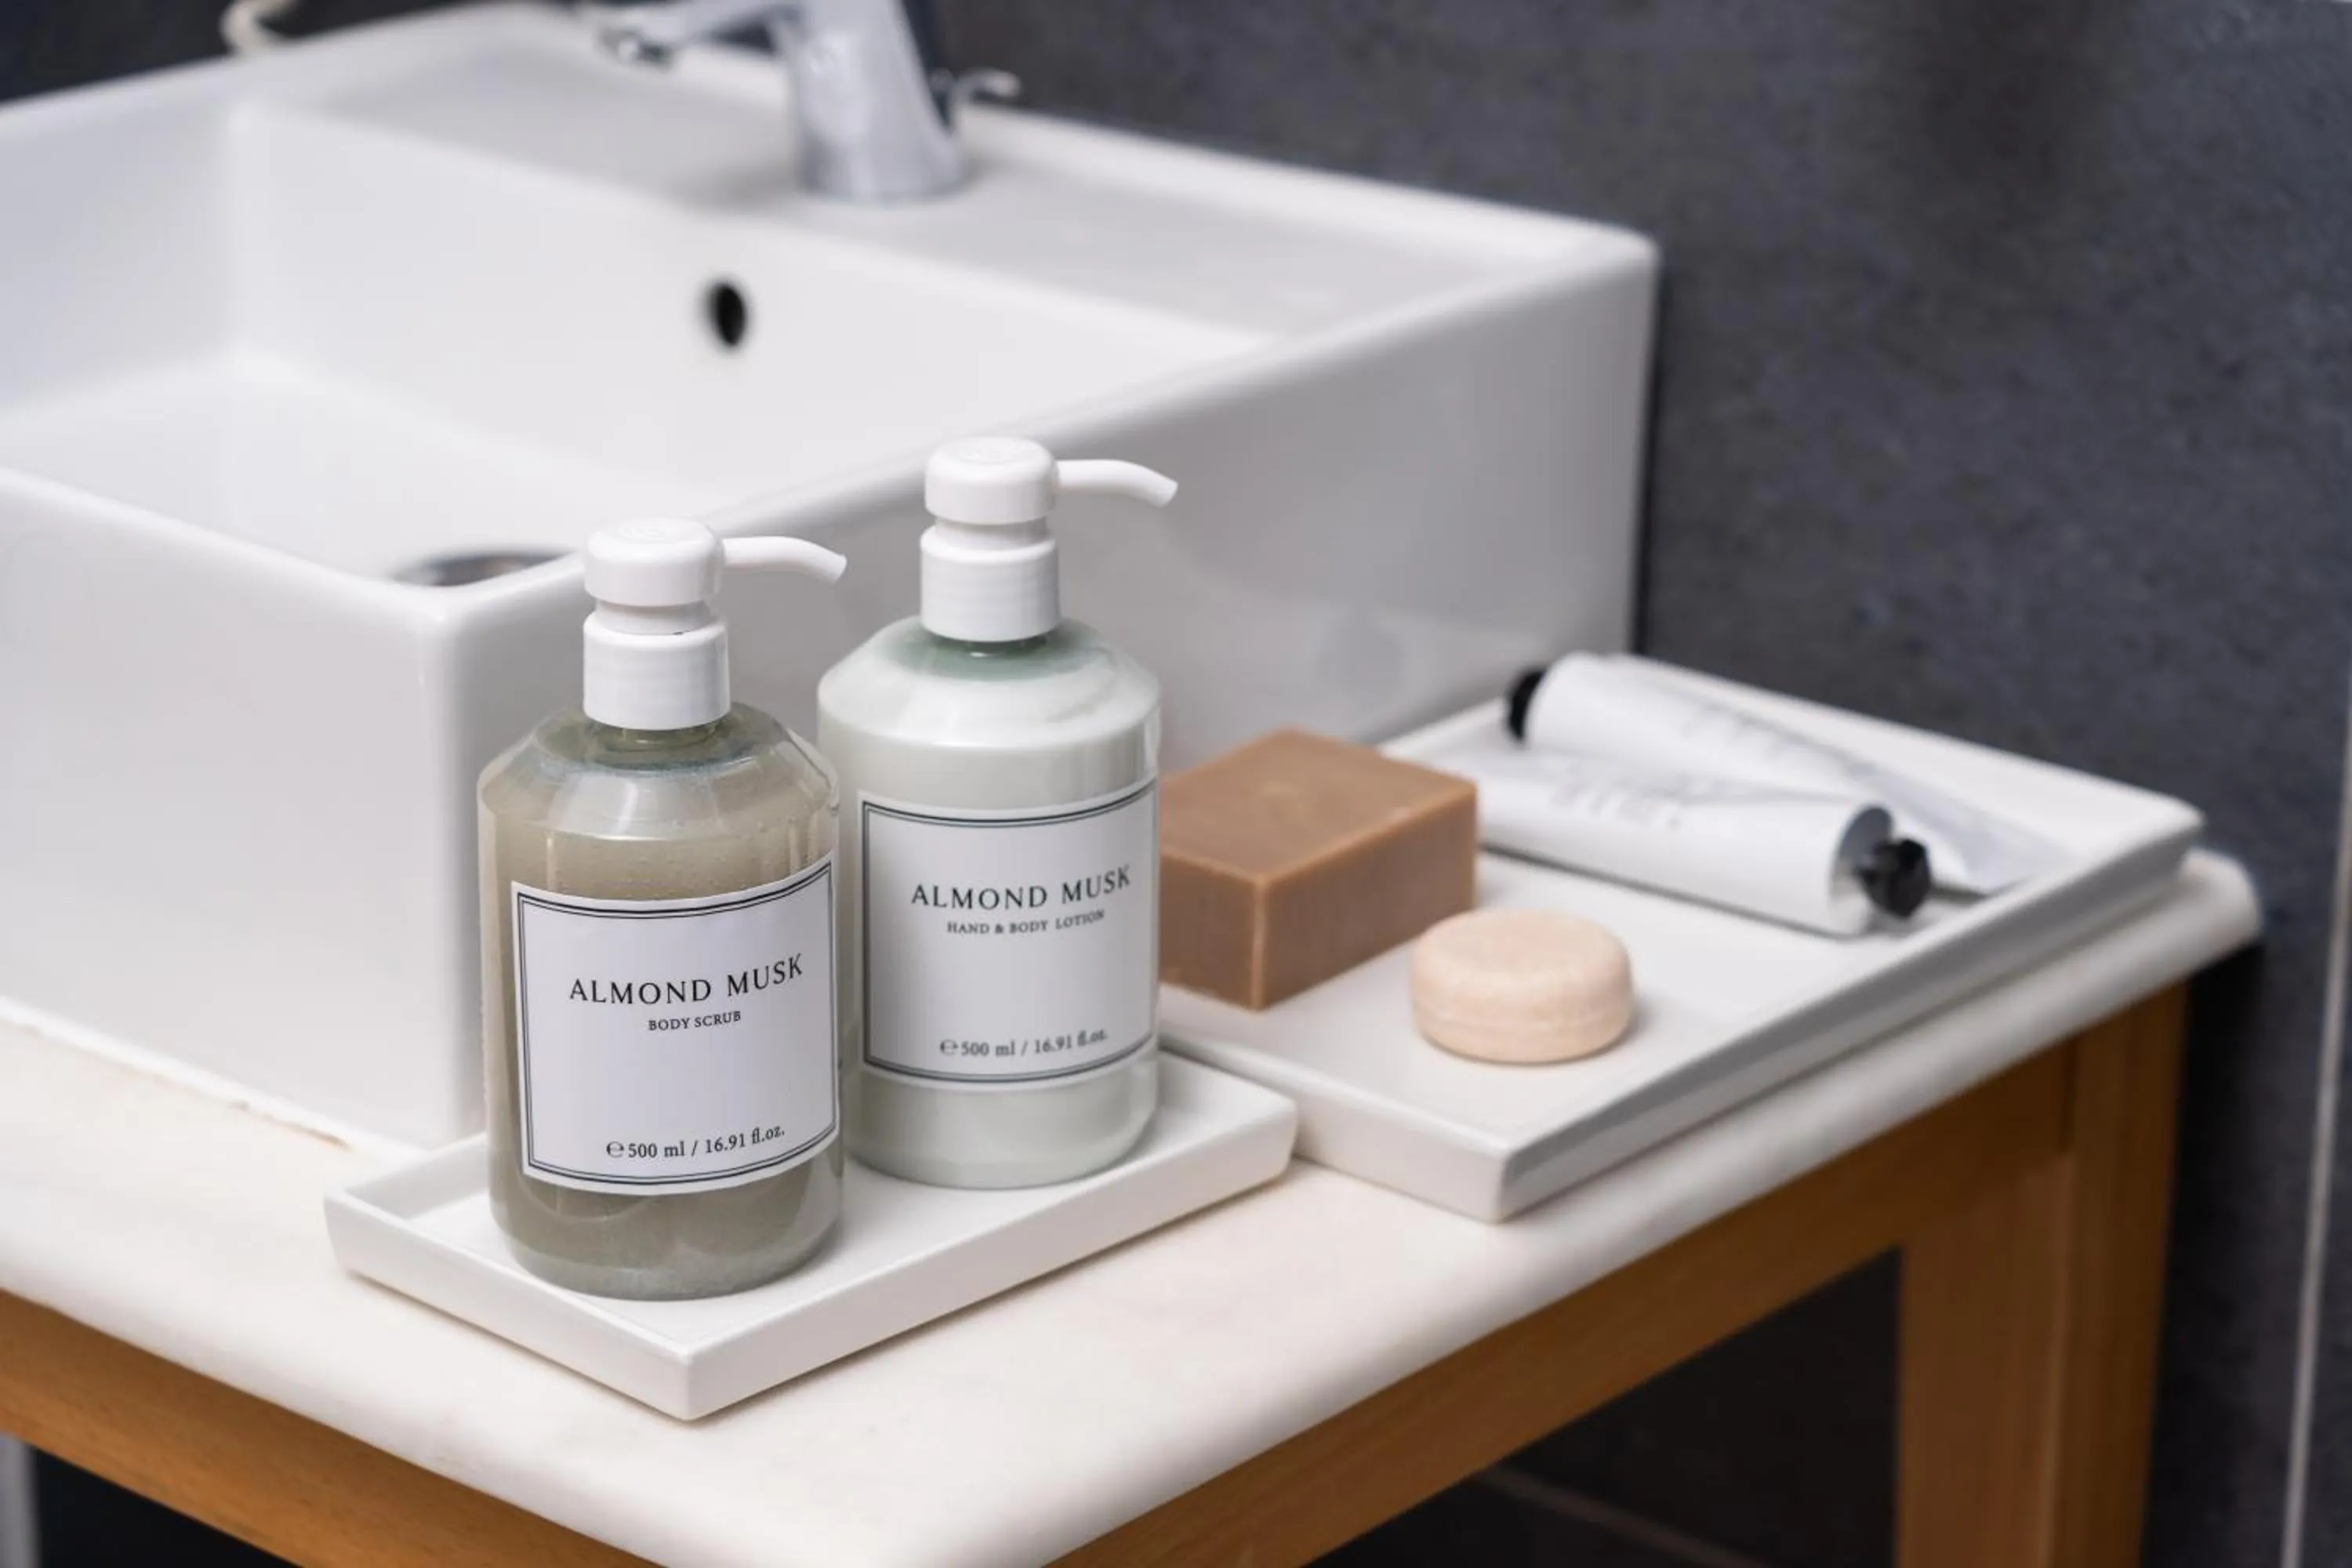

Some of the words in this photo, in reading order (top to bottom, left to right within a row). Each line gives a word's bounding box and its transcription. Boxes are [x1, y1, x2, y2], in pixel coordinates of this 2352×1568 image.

[911, 884, 1048, 910] ALMOND
[1061, 863, 1130, 904] MUSK
[946, 921, 989, 935] HAND
[994, 922, 1005, 935] &
[1008, 919, 1049, 934] BODY
[1054, 909, 1105, 930] LOTION
[569, 978, 712, 1004] ALMOND
[726, 953, 803, 997] MUSK
[648, 1017, 691, 1031] BODY
[695, 1010, 742, 1028] SCRUB
[995, 1040, 1016, 1057] ml
[1020, 1040, 1029, 1058] /
[1034, 1033, 1073, 1054] 16.91
[663, 1139, 685, 1157] ml
[690, 1139, 699, 1157] /
[705, 1132, 745, 1154] 16.91
